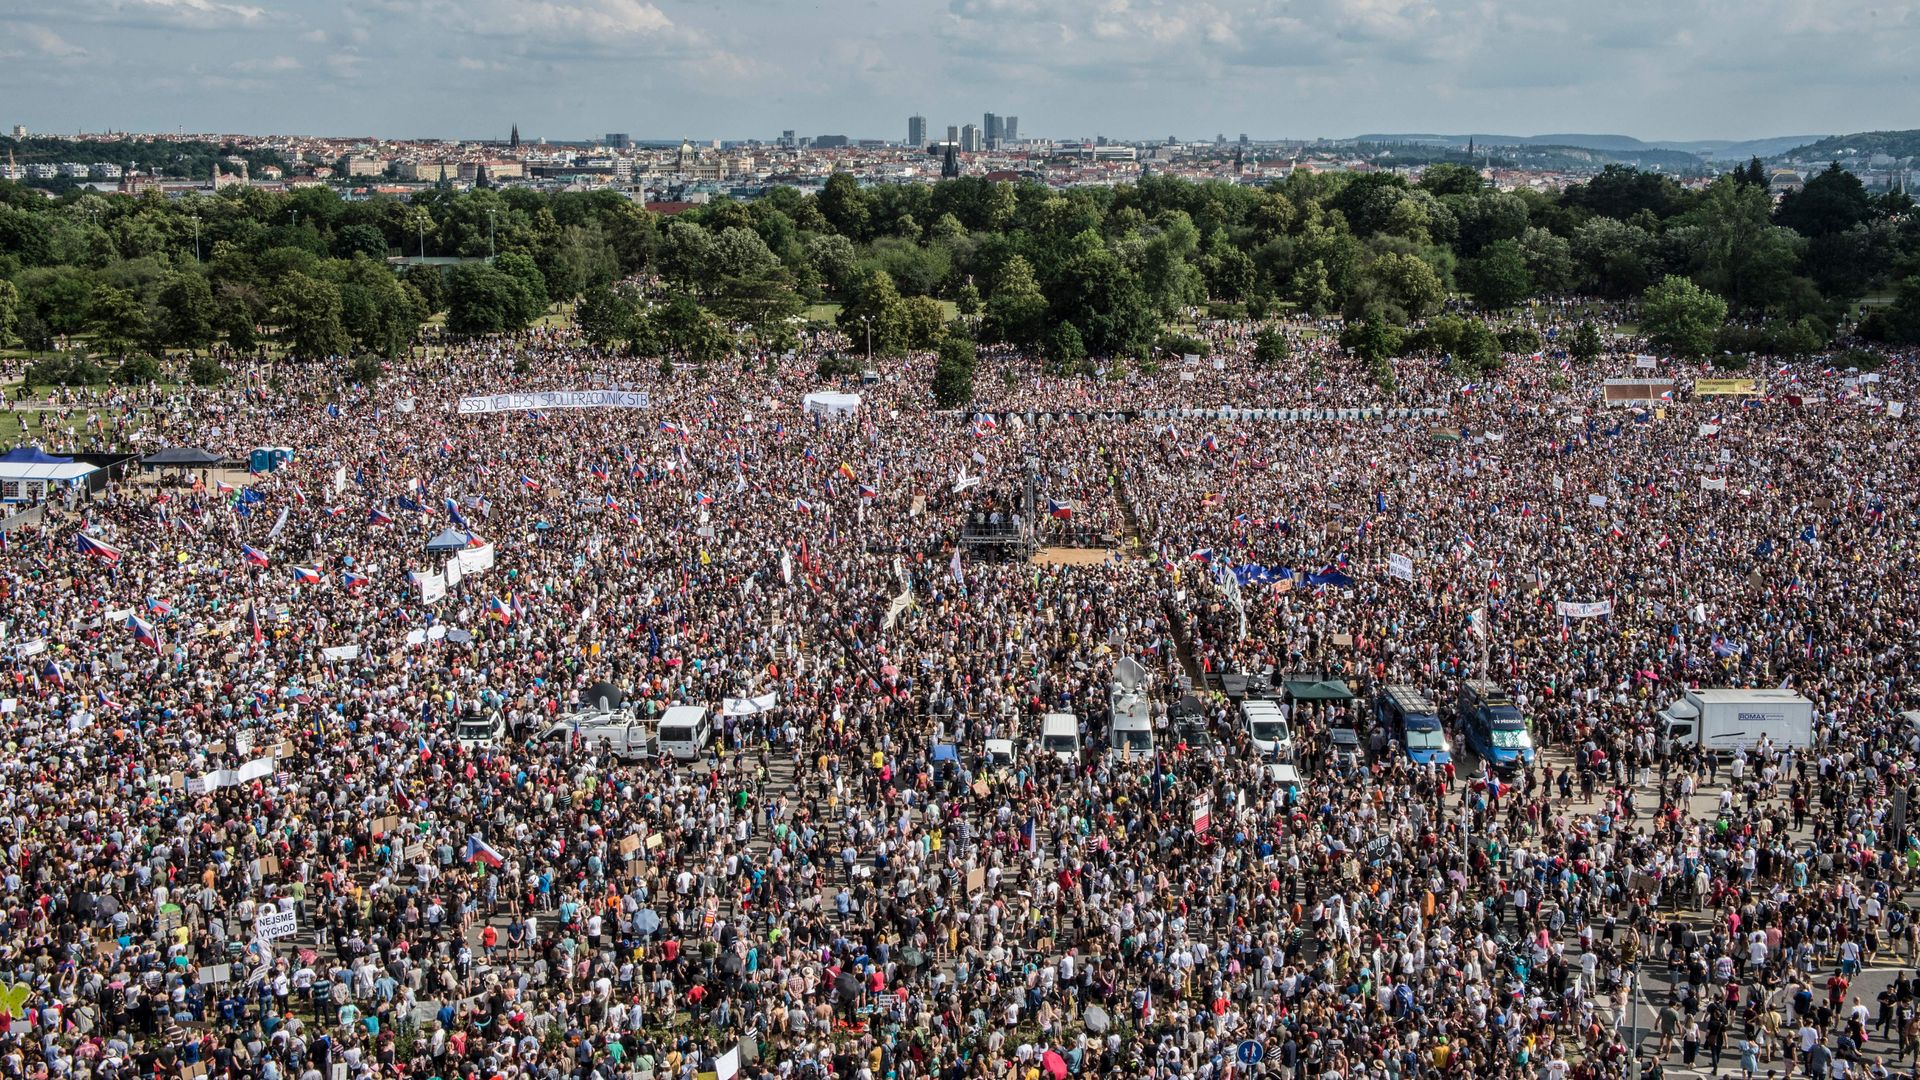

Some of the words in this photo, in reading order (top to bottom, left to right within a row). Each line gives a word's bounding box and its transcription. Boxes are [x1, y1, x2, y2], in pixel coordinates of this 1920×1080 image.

[541, 392, 624, 406] SPOLUPRACOVNÍK
[627, 393, 648, 406] STB
[259, 912, 294, 926] NEJSME
[259, 923, 295, 938] VÝCHOD
